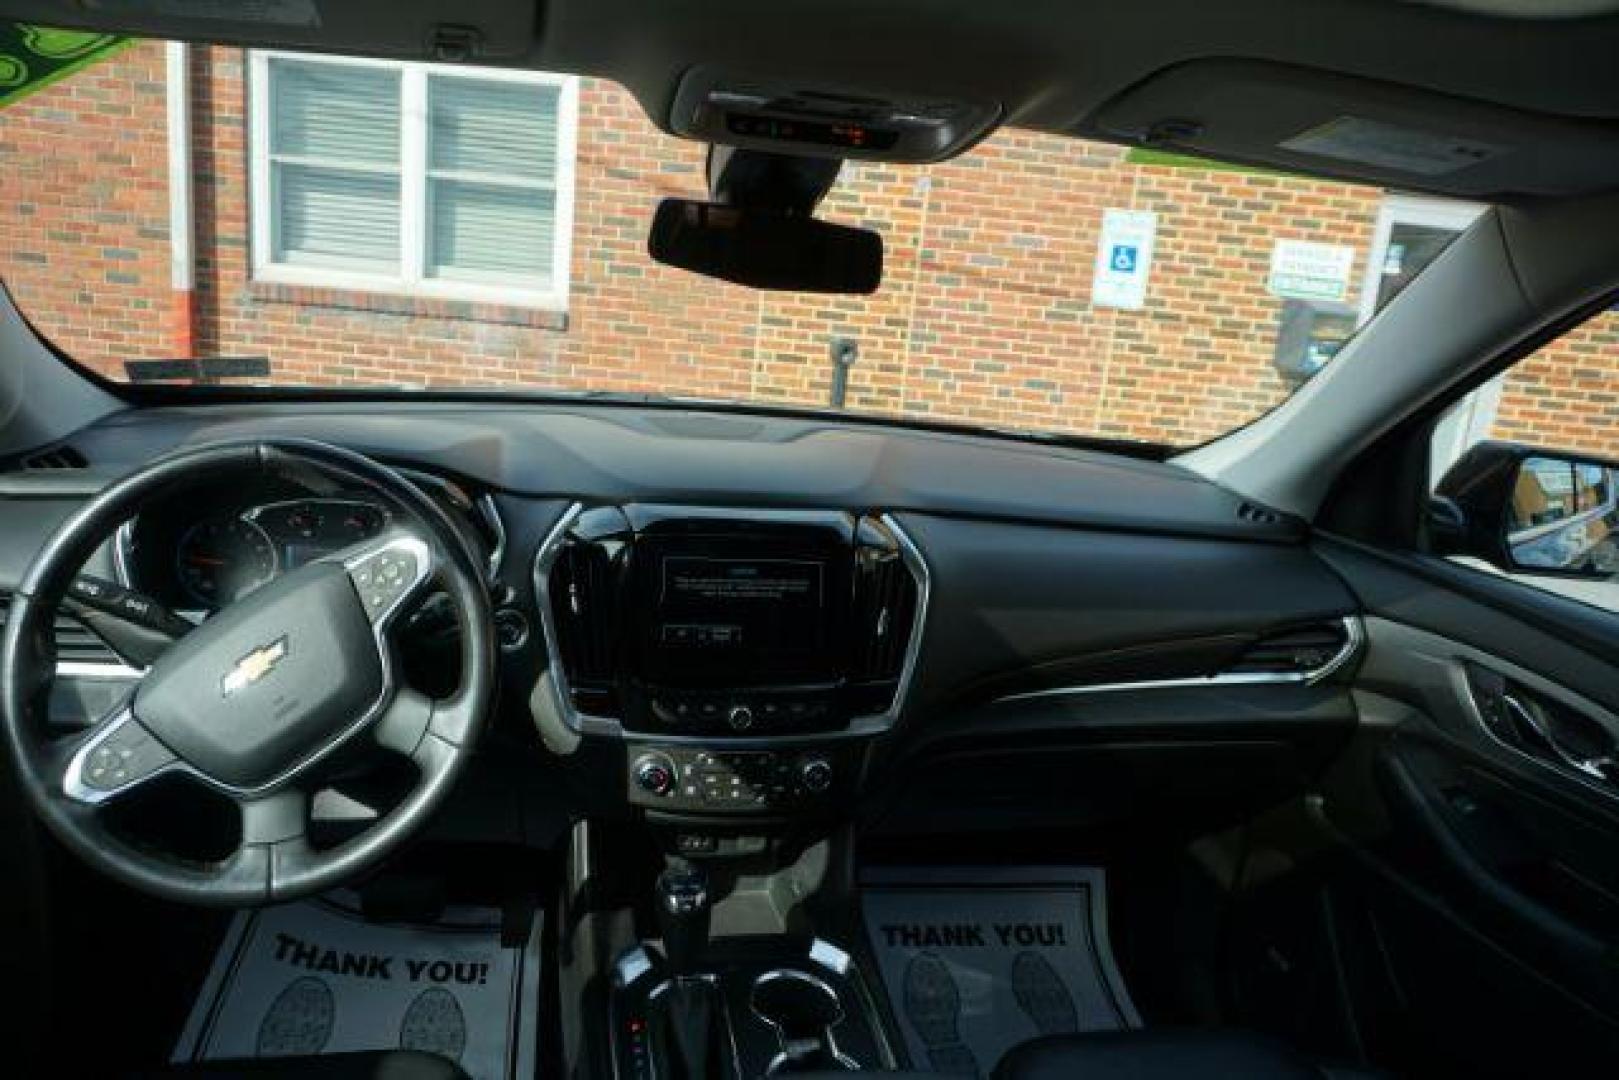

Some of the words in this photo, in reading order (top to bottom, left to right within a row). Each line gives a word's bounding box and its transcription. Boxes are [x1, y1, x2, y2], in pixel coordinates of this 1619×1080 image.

[881, 922, 984, 947] THANK
[994, 922, 1066, 946] YOU!
[275, 932, 393, 980] THANK
[405, 959, 489, 985] YOU!
